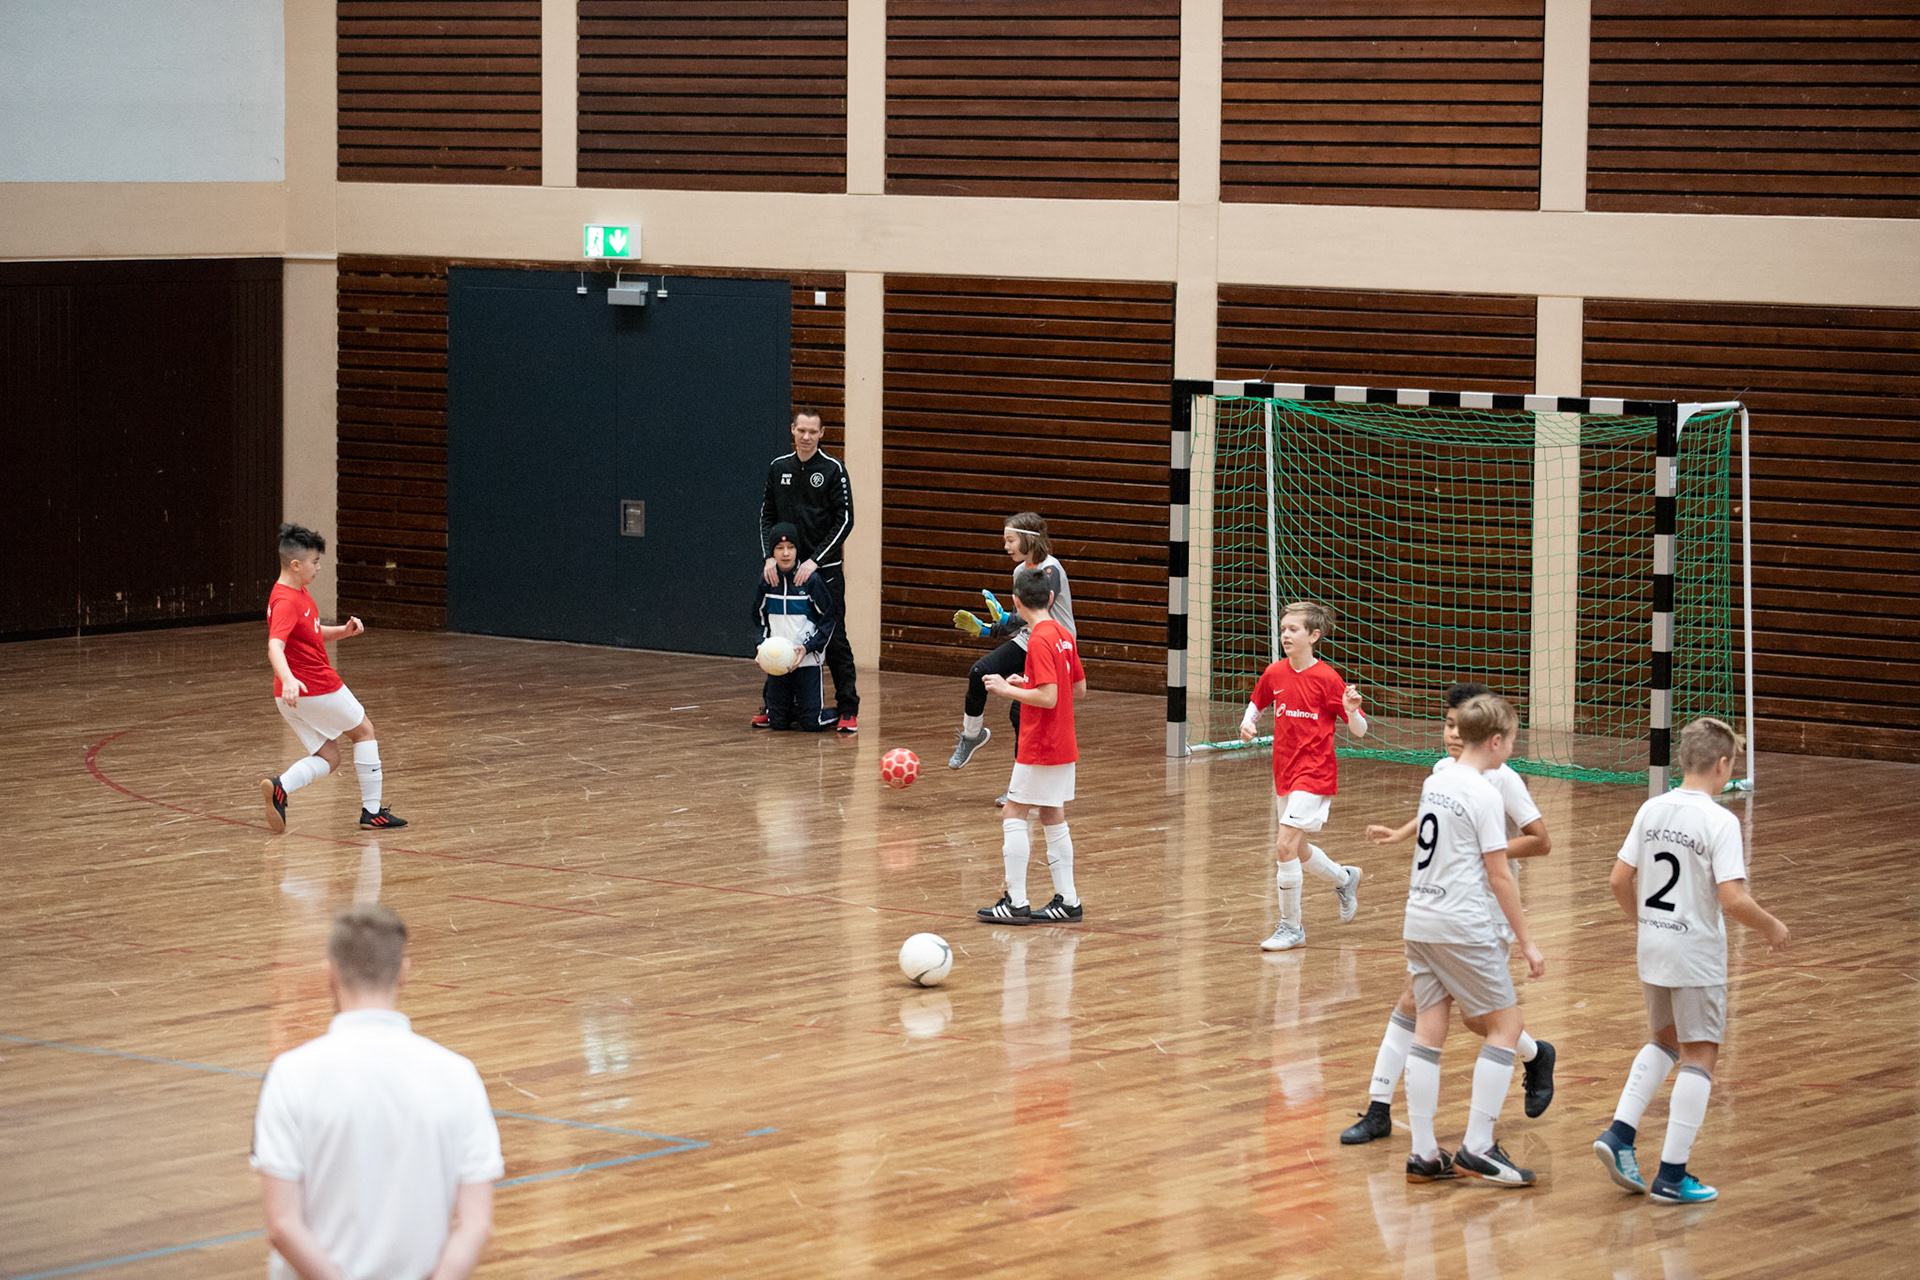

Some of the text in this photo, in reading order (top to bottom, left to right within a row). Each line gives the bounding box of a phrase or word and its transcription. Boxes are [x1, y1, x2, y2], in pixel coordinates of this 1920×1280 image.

[1285, 709, 1318, 720] mainova
[1417, 812, 1439, 871] 9
[1662, 829, 1705, 856] RODGAU
[1645, 851, 1680, 912] 2
